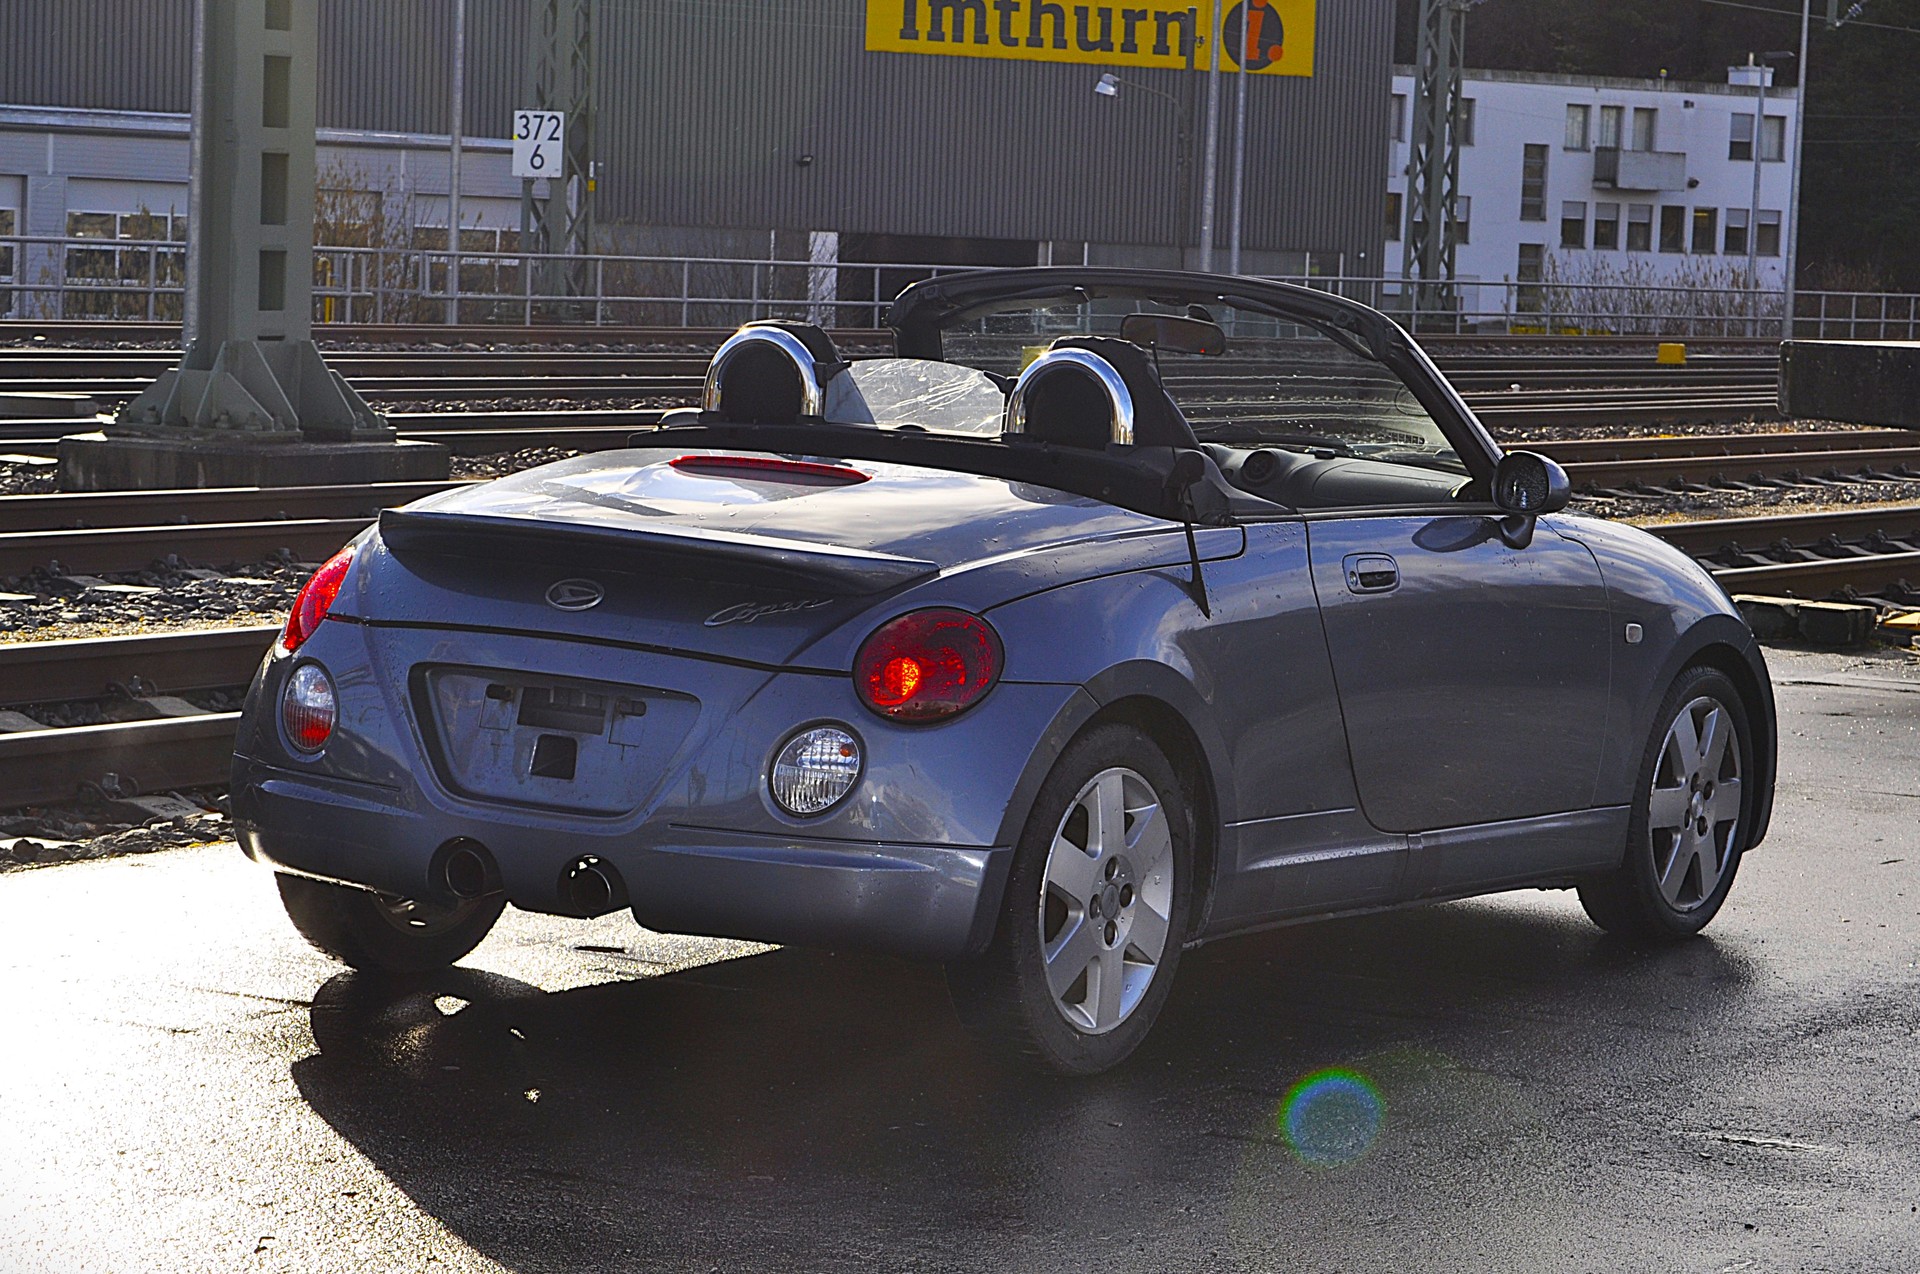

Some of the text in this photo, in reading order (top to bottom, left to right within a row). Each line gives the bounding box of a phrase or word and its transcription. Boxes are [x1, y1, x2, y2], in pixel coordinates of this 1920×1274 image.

[899, 0, 1189, 56] Imthurn
[517, 114, 560, 141] 372
[530, 144, 545, 170] 6
